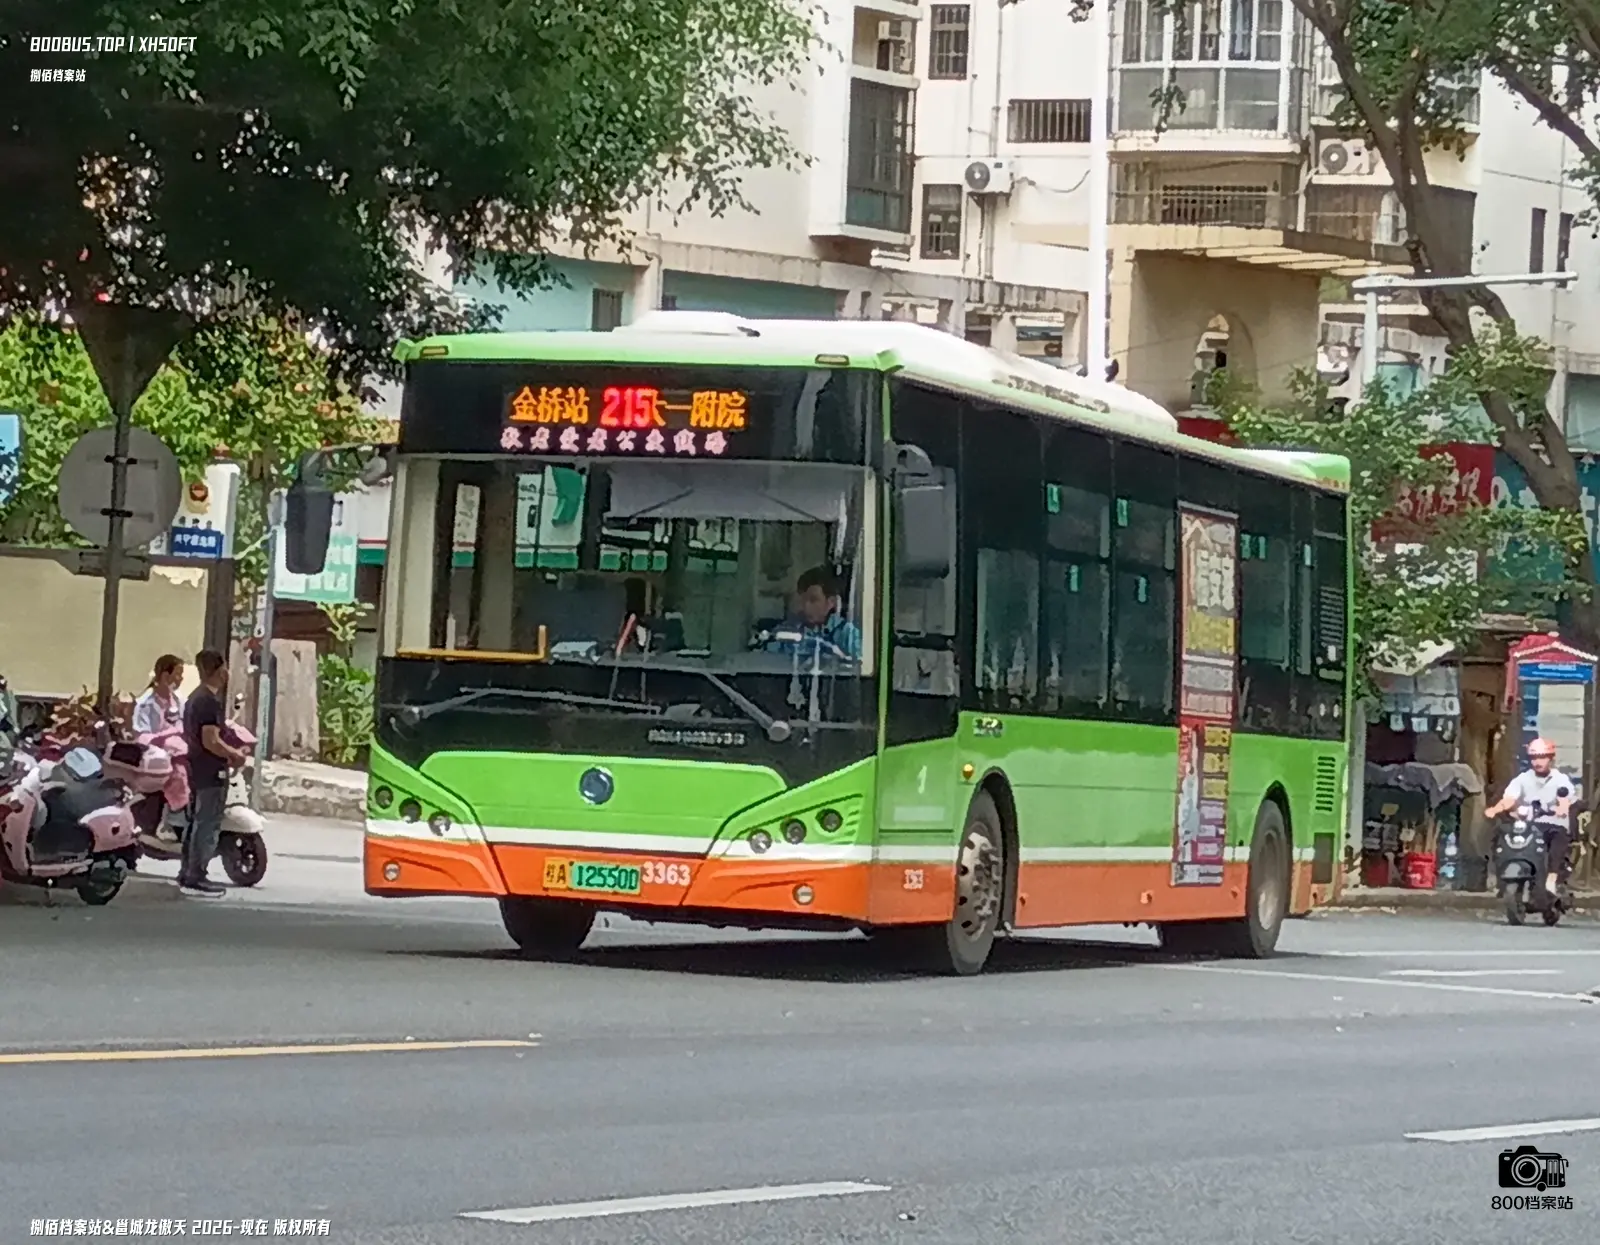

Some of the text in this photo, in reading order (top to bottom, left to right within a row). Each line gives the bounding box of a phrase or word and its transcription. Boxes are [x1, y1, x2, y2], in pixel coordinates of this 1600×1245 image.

[509, 386, 590, 424] 金桥站
[600, 387, 655, 428] 215
[642, 861, 691, 887] 3363
